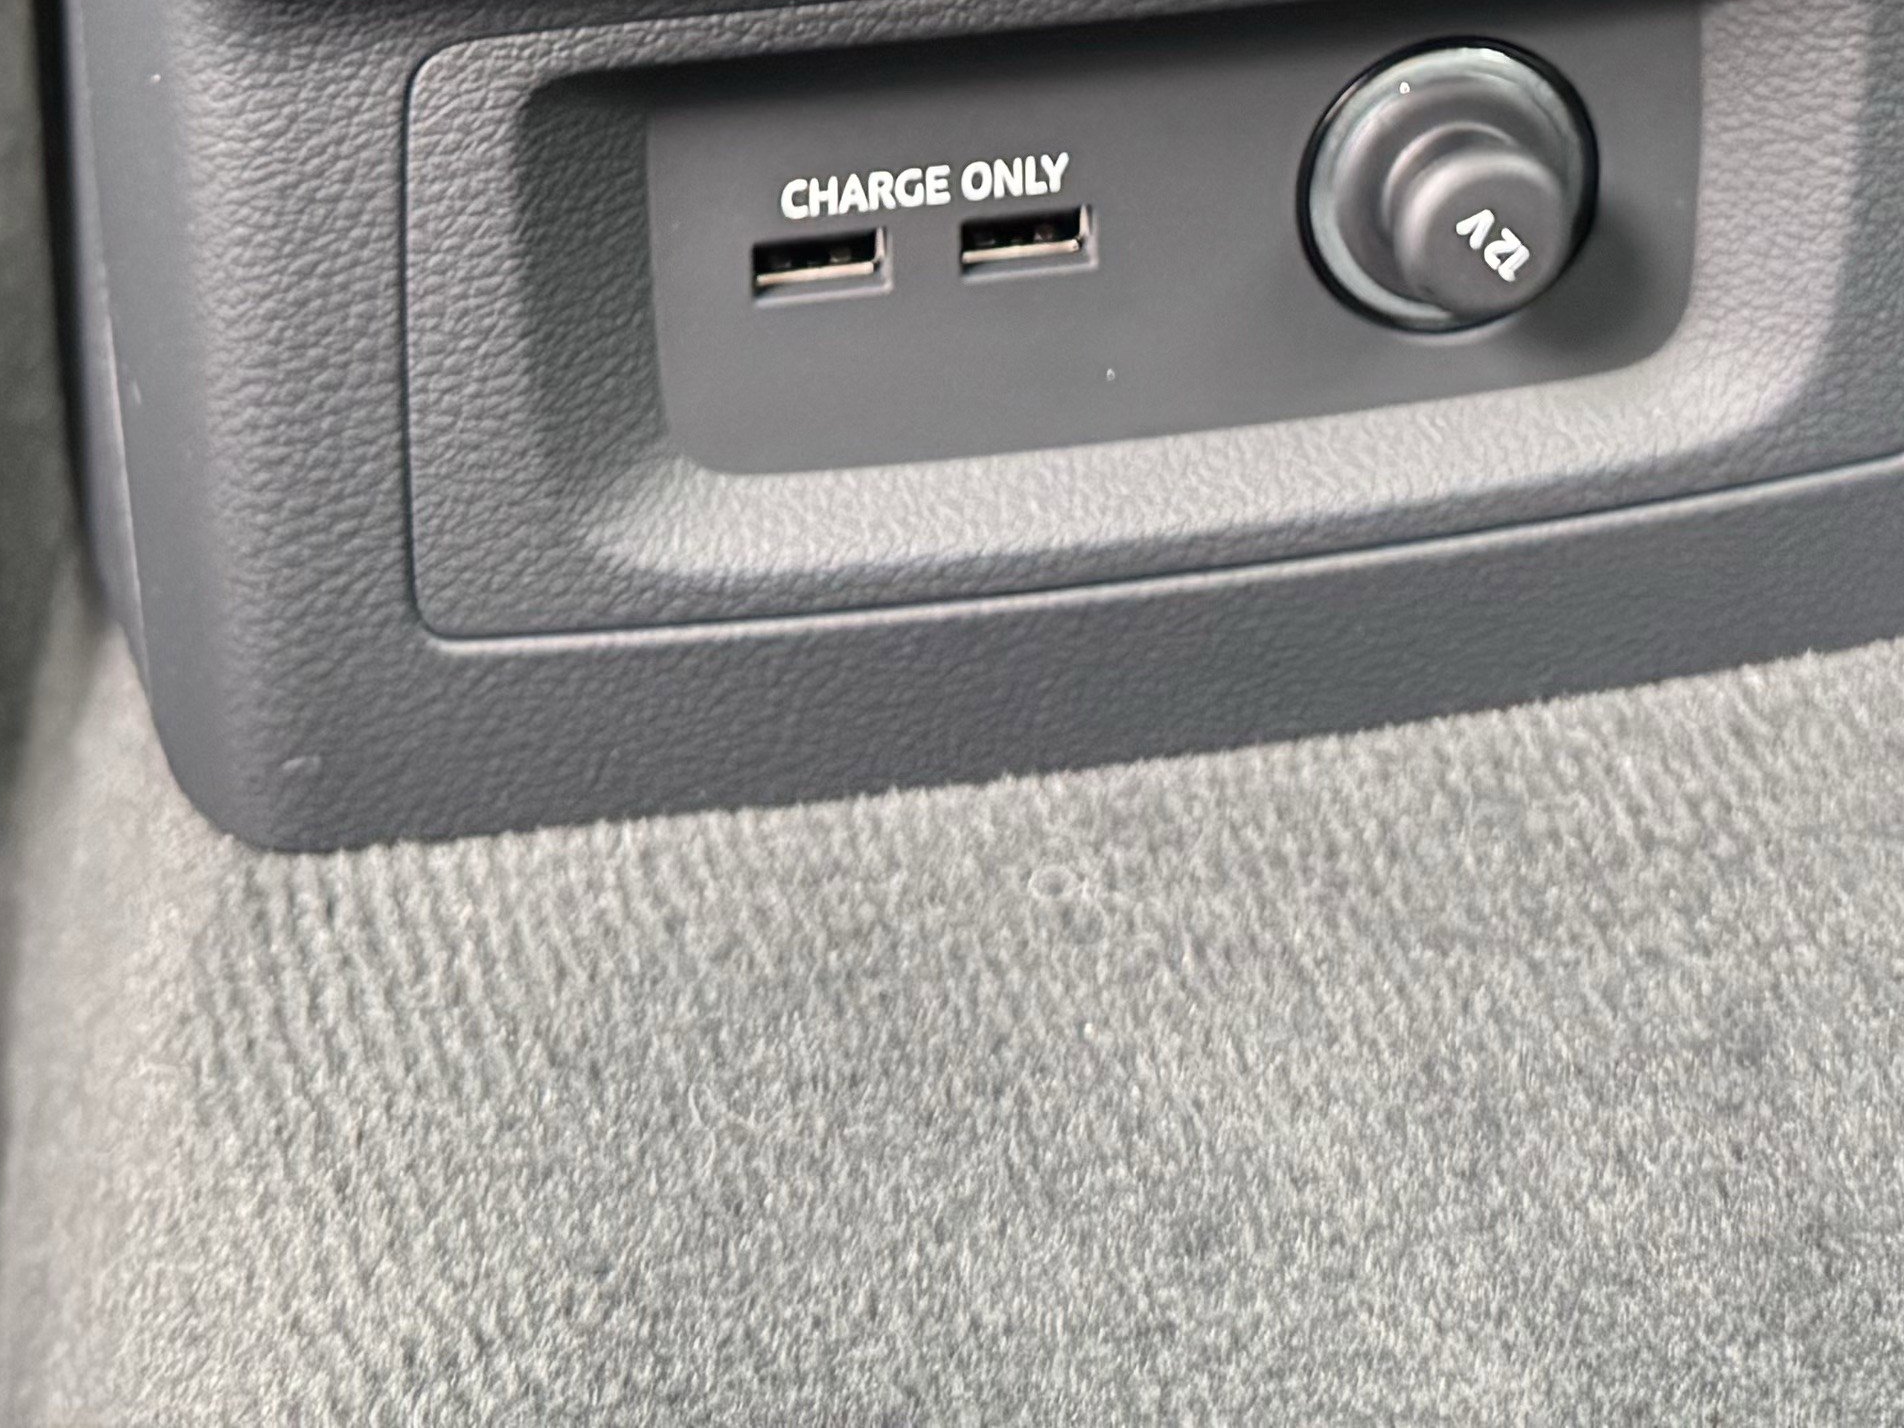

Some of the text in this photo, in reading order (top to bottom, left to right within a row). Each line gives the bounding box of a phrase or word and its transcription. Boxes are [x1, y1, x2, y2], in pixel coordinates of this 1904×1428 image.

[780, 151, 1070, 220] CHARGE ONLY
[1455, 208, 1530, 282] 12V
